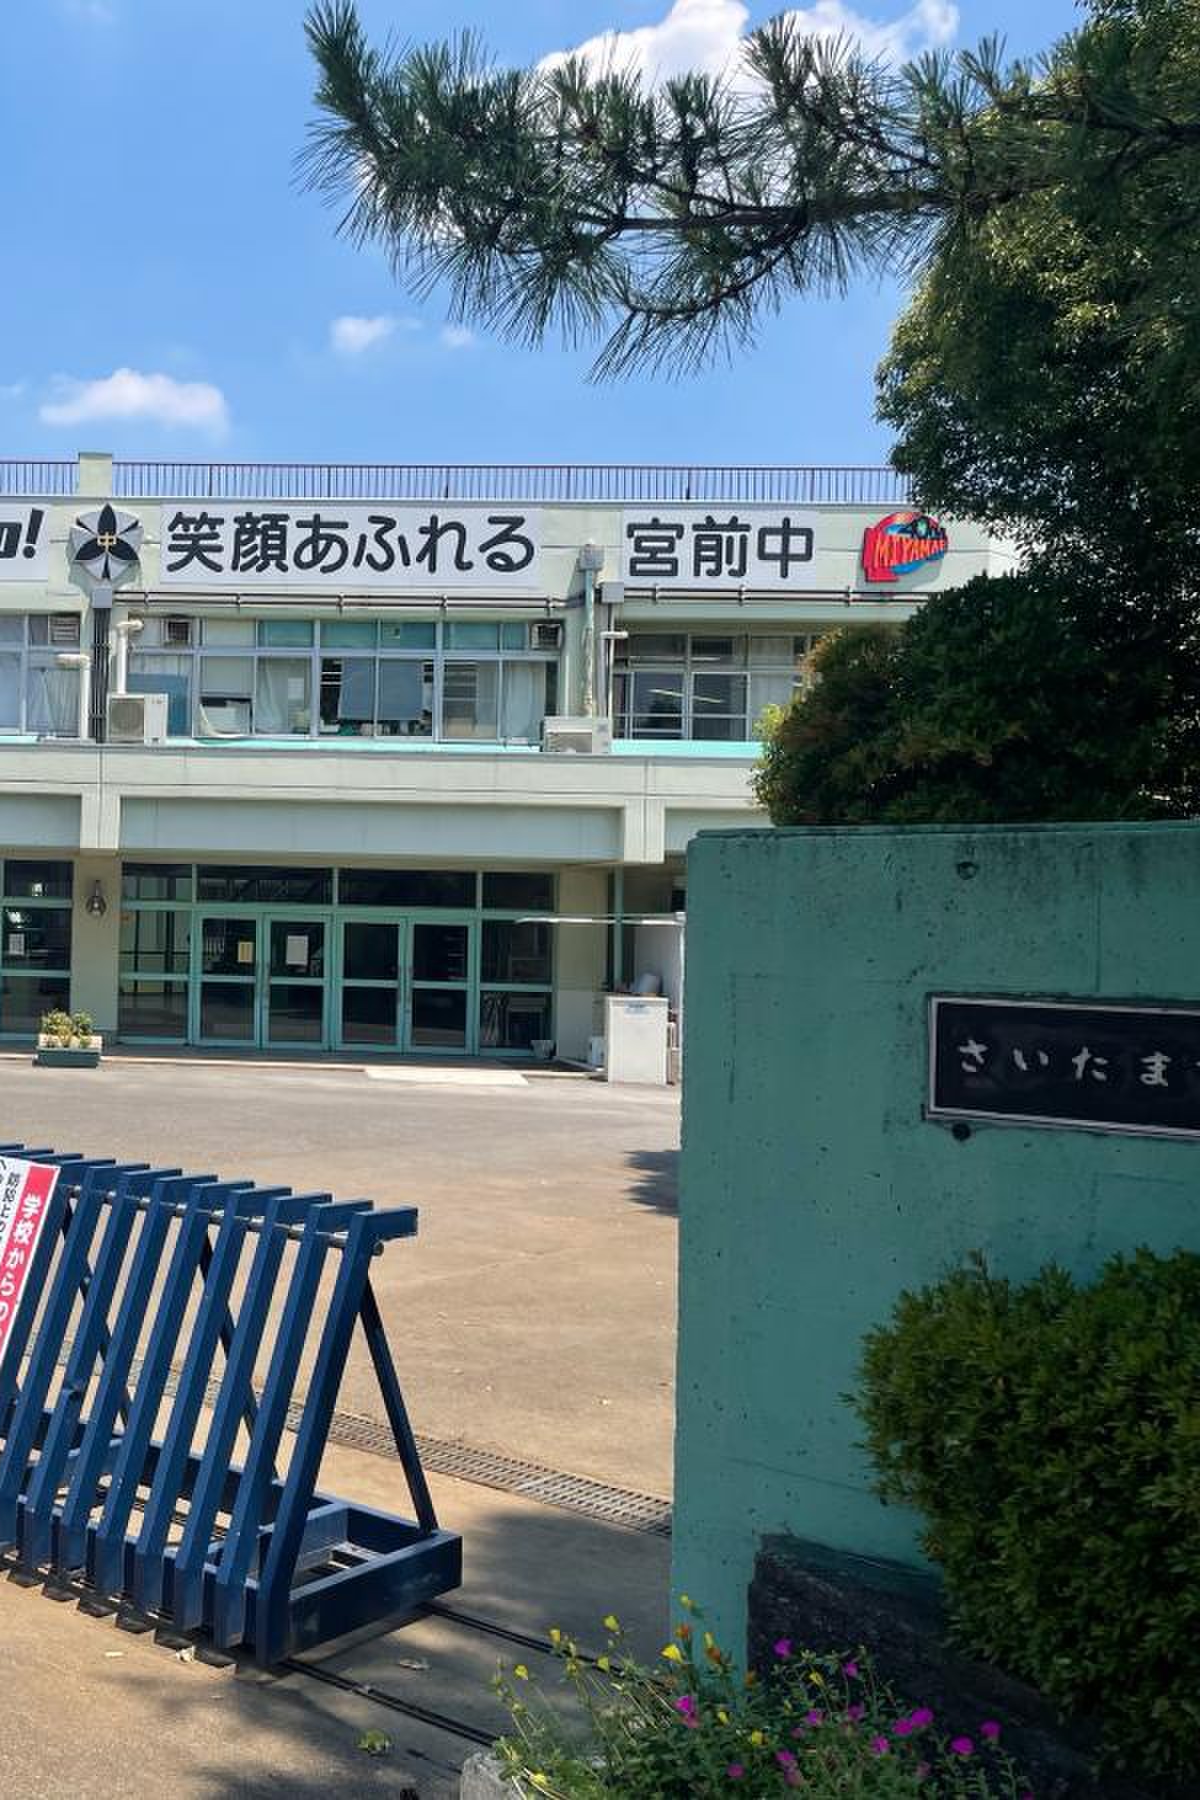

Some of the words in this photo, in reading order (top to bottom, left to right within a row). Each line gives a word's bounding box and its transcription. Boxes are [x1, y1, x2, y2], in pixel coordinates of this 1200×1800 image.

[166, 510, 536, 575] 笑顔あふれる
[626, 515, 815, 579] 宮前中
[959, 1038, 1200, 1087] さいたま
